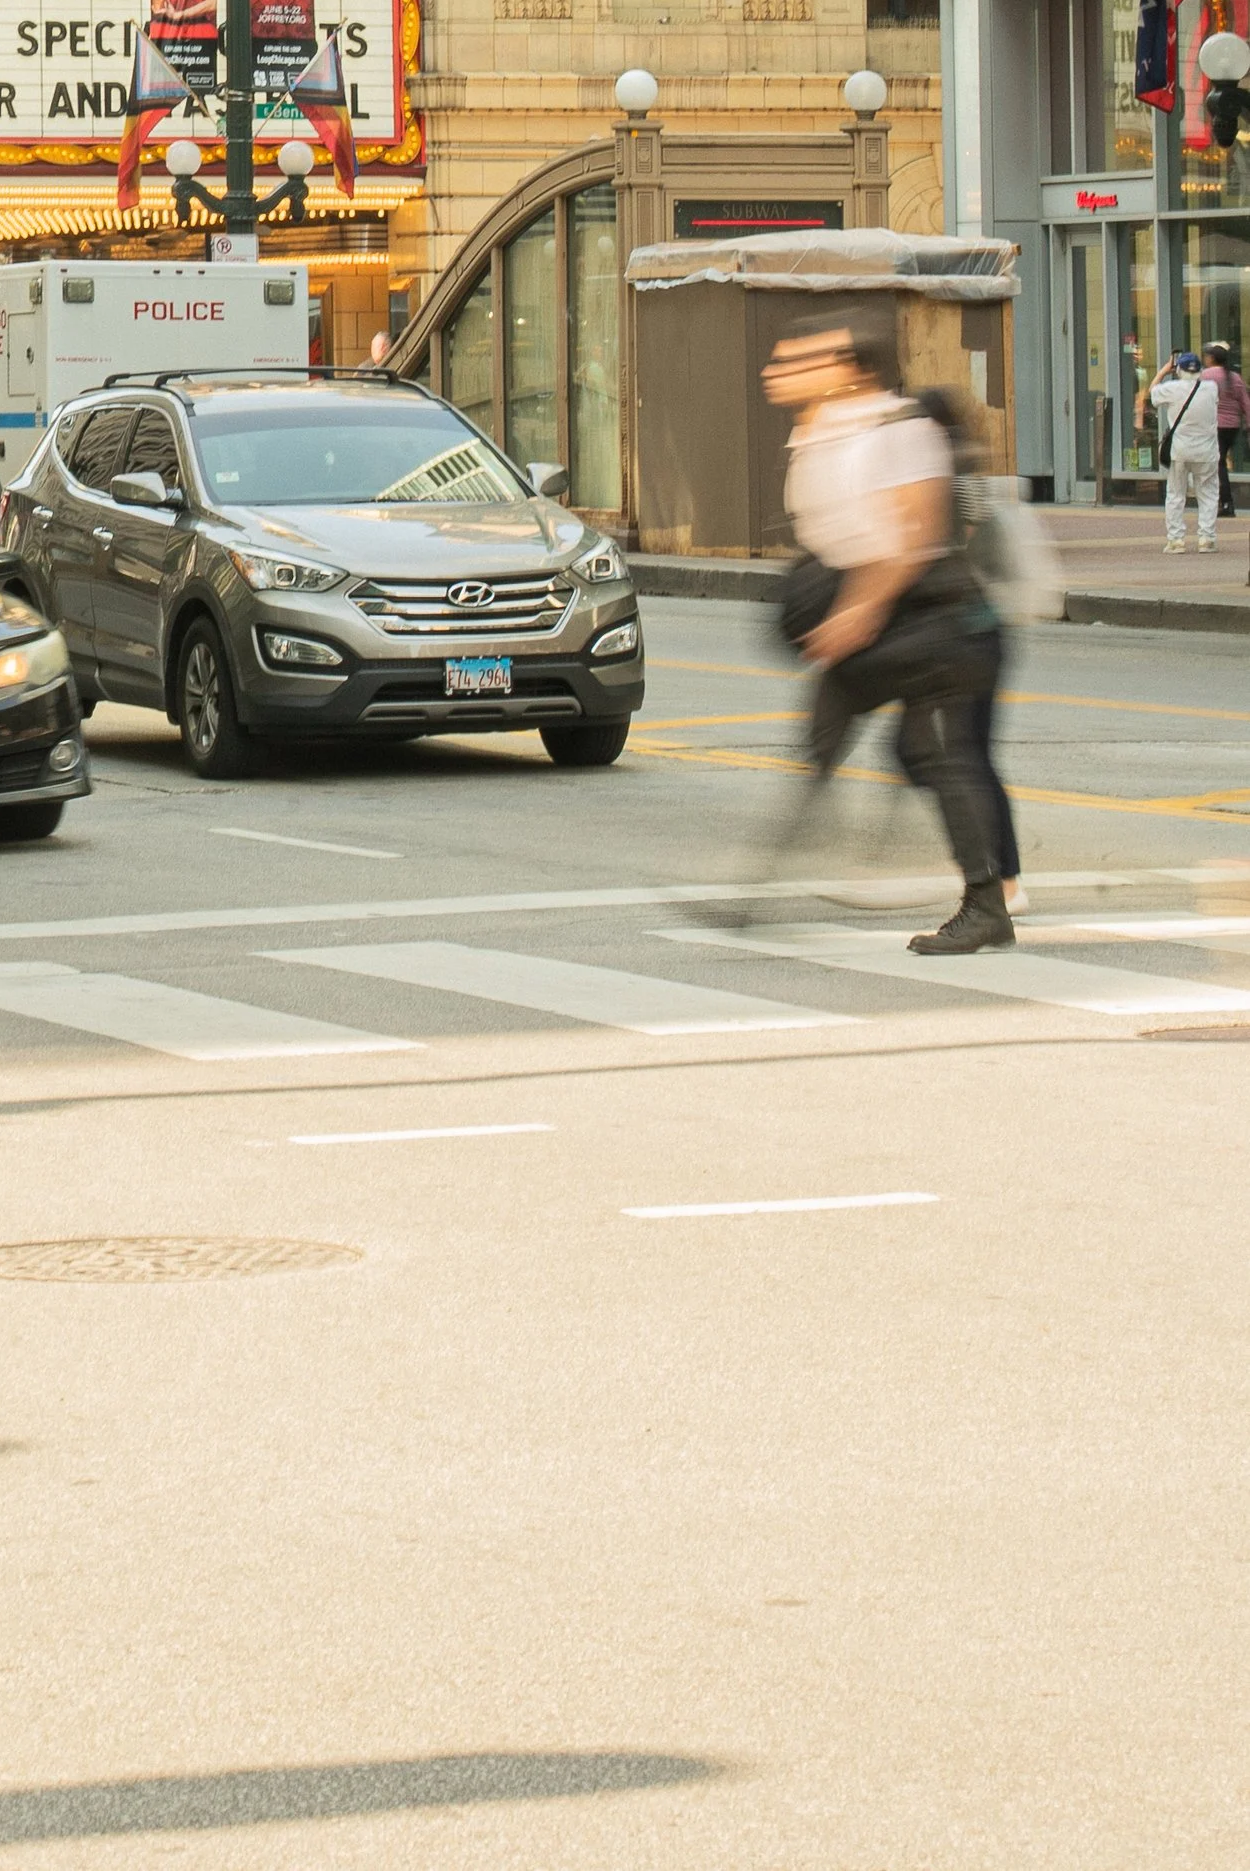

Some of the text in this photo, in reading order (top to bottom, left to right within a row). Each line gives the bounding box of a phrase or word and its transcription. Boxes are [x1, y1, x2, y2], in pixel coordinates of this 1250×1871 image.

[257, 14, 306, 25] JOFFREY.ORG
[17, 20, 150, 58] SPECI
[49, 81, 127, 118] AND
[722, 204, 790, 220] SUBWAY
[133, 301, 225, 321] POLICE
[448, 668, 509, 688] E74 2964
